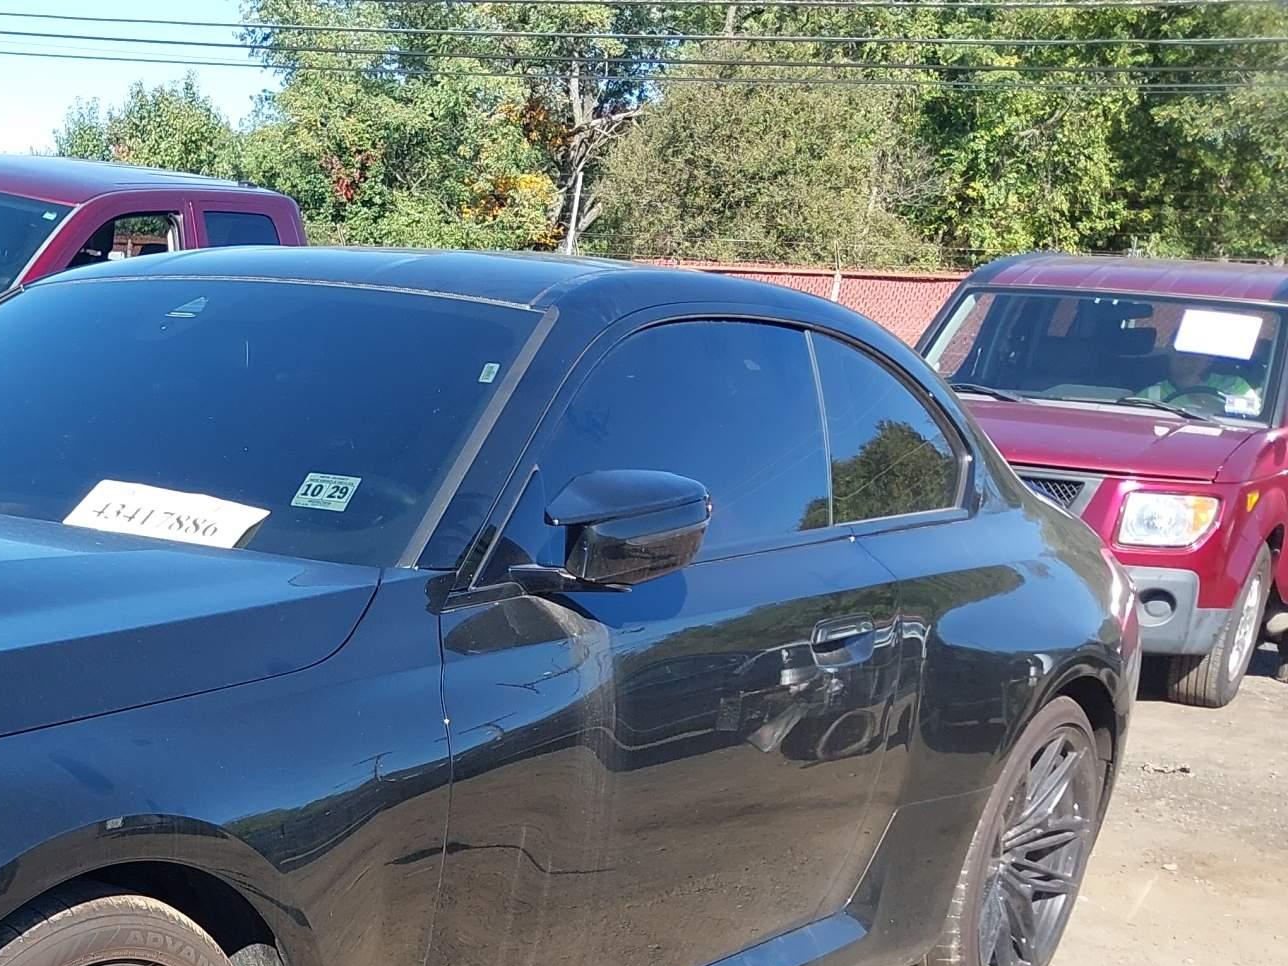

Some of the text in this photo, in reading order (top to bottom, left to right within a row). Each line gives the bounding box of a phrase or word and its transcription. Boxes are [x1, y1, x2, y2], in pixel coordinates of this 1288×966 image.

[300, 482, 350, 500] 10 29
[92, 502, 219, 537] 43417886
